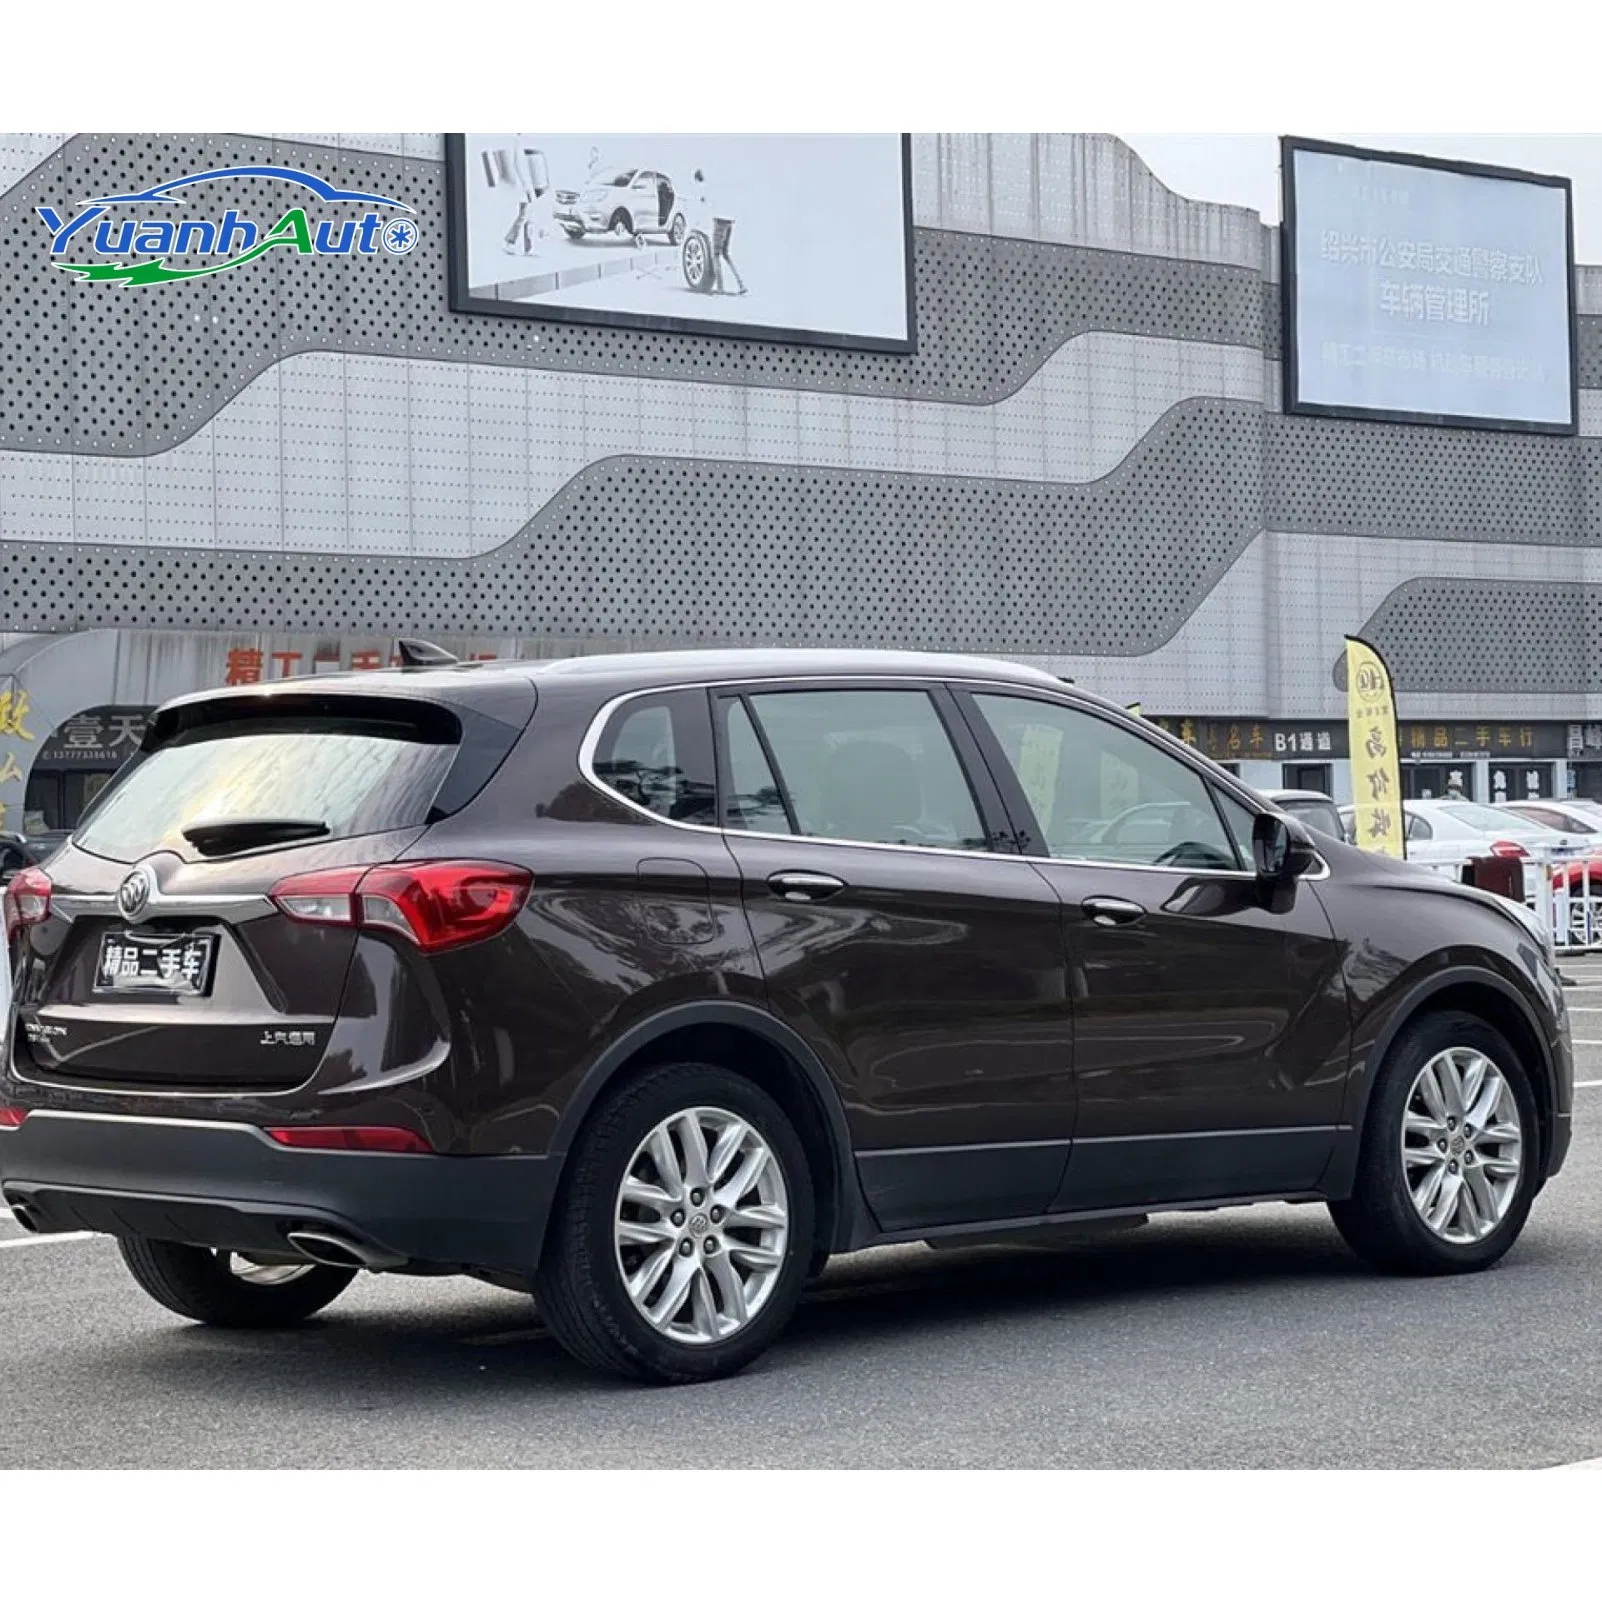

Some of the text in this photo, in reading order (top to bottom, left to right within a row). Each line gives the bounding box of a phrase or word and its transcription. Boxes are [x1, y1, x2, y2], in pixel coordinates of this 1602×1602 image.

[1379, 281, 1490, 326] 车辆管理所
[1275, 731, 1331, 752] B1通道
[1399, 726, 1533, 748] 精品二手车行
[104, 942, 201, 980] 精品二手车
